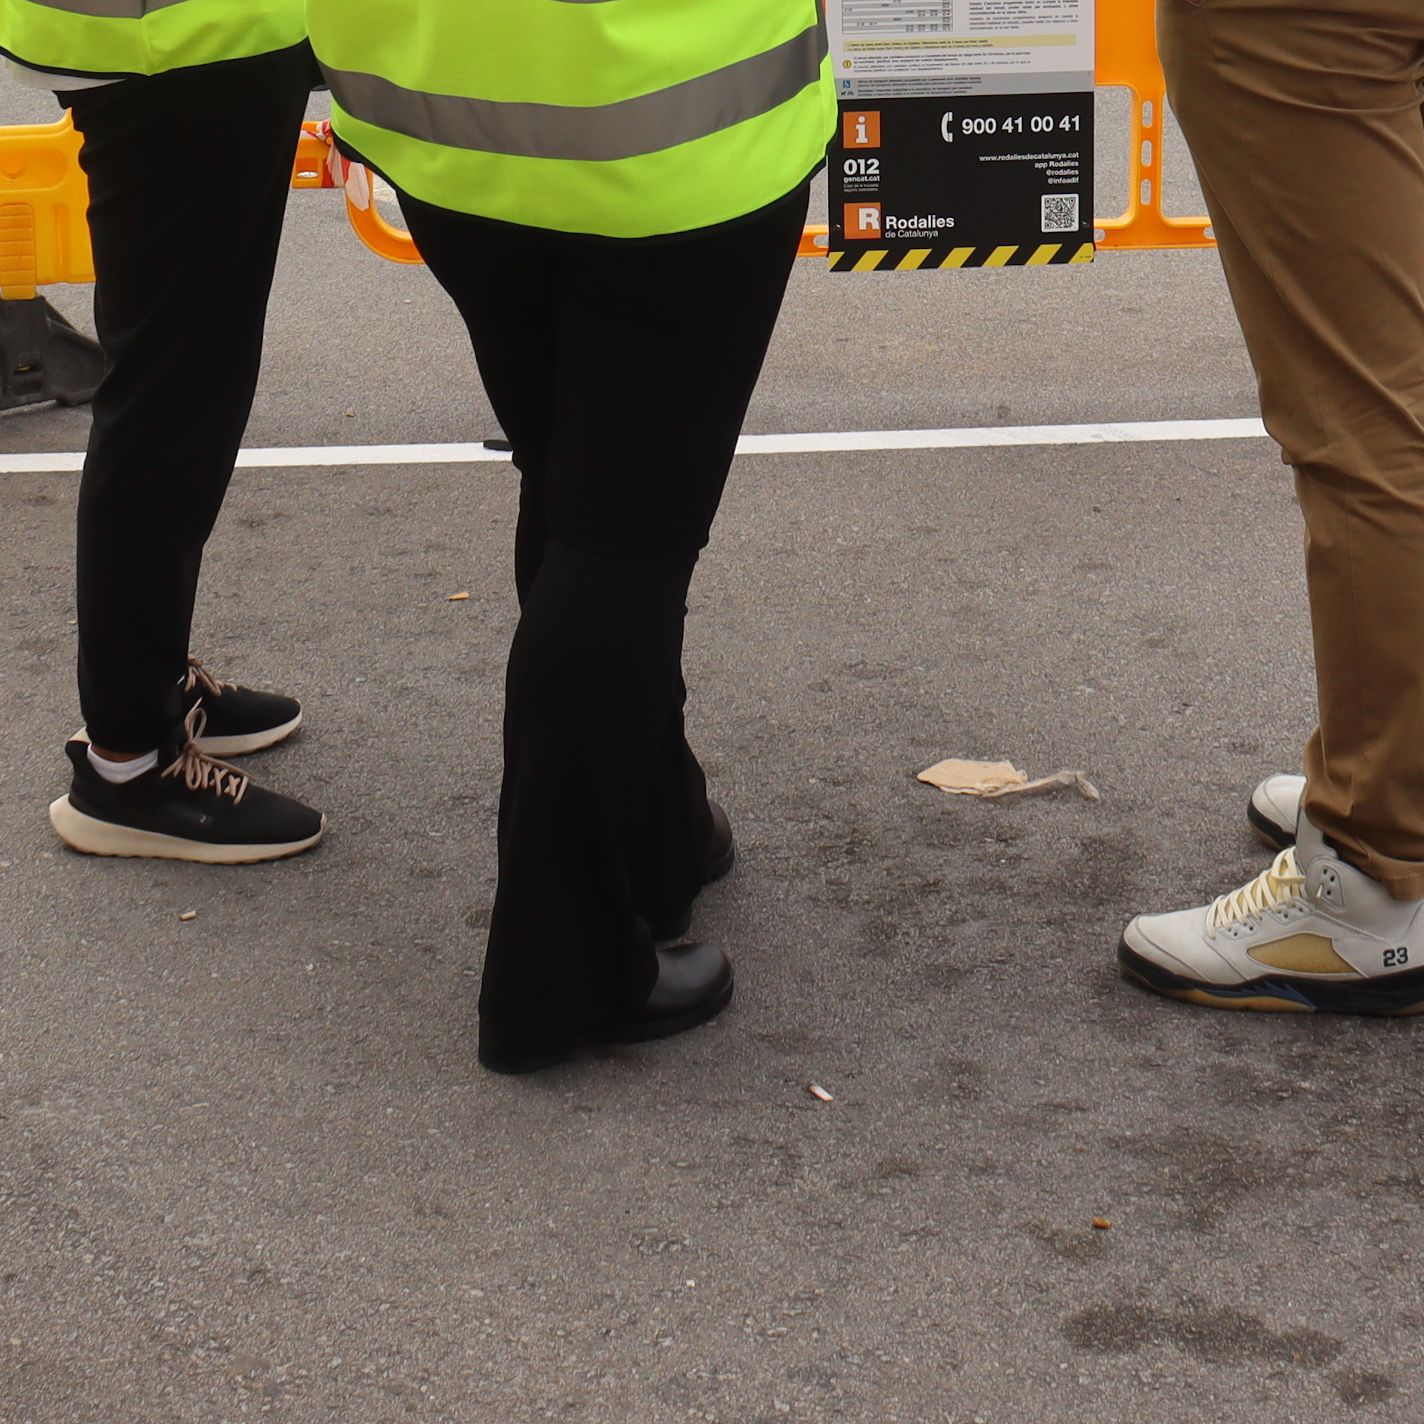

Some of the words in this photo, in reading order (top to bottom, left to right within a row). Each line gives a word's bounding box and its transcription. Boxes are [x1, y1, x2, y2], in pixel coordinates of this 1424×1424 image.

[962, 118, 997, 135] 900
[1002, 116, 1023, 134] 41
[1030, 116, 1054, 132] 00
[1059, 114, 1080, 132] 41
[844, 158, 880, 176] 012
[858, 208, 880, 230] R
[885, 214, 955, 230] Rodalies
[885, 230, 896, 238] de
[898, 230, 938, 240] Catalunya
[1382, 946, 1408, 968] 23
